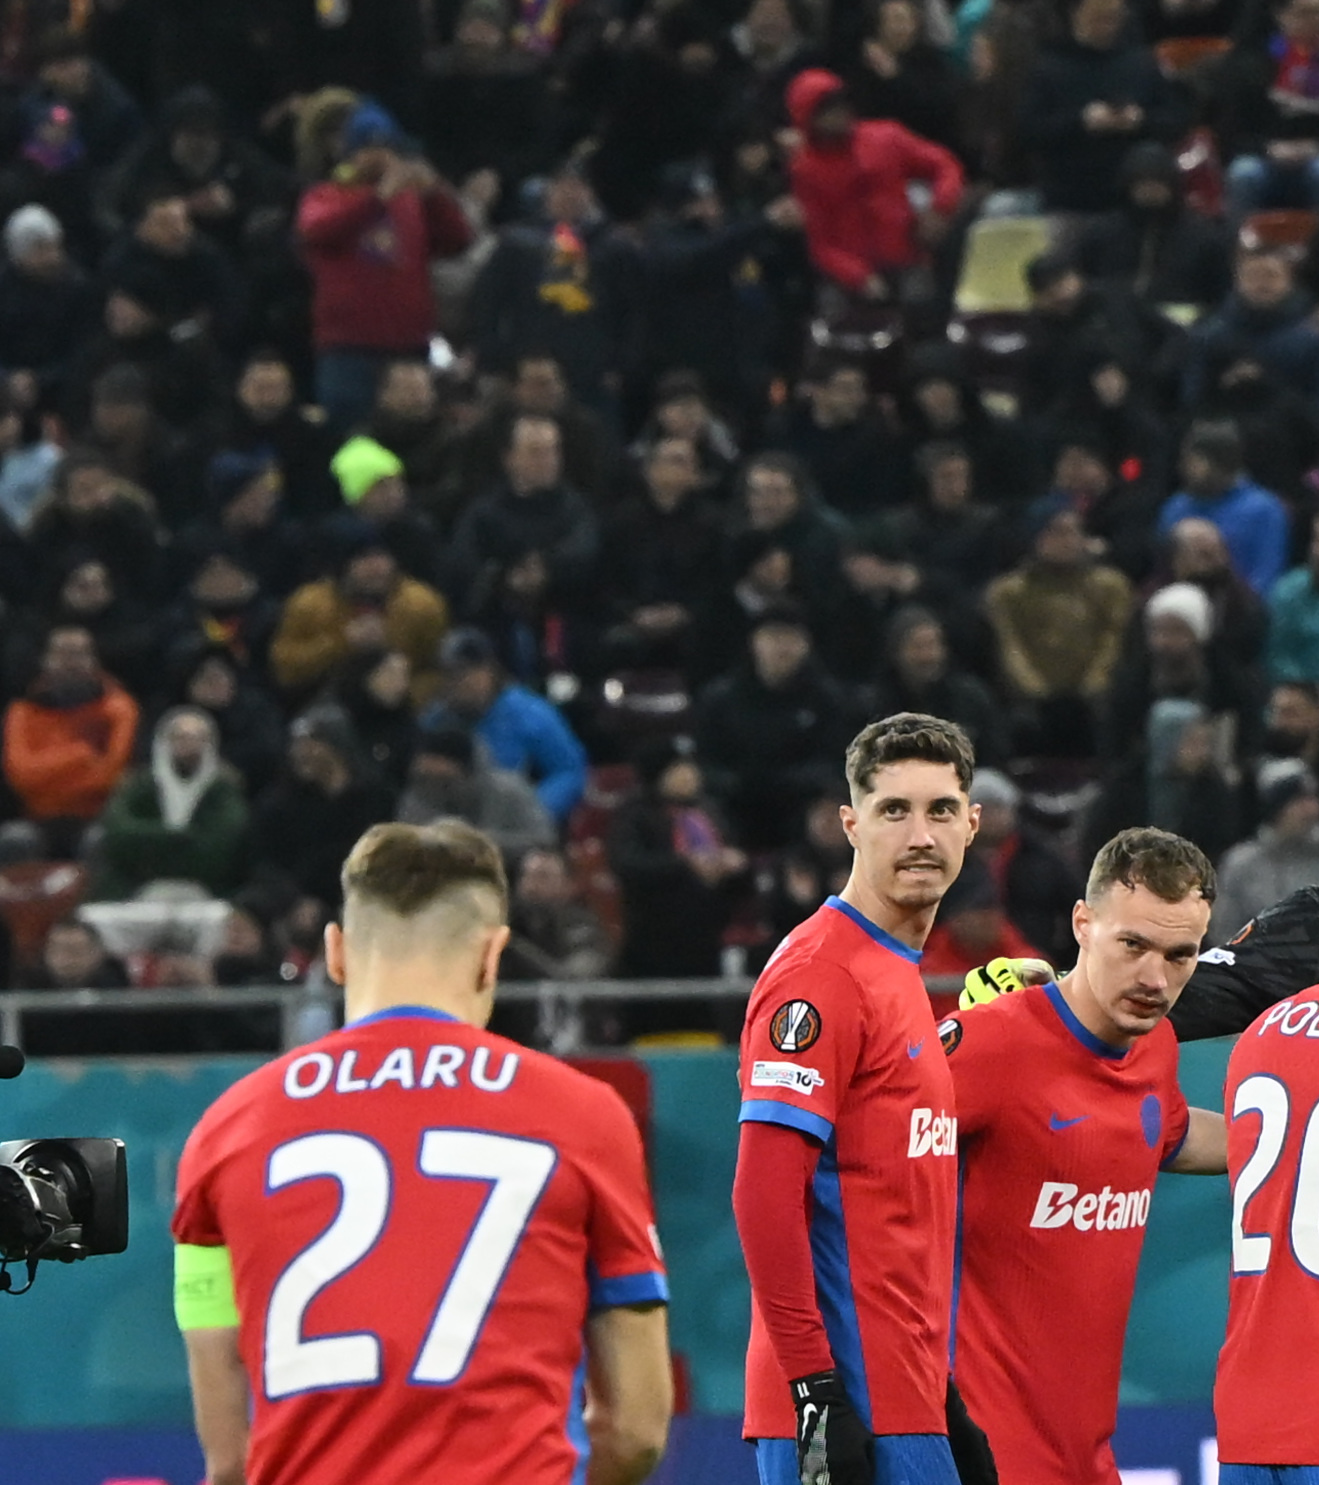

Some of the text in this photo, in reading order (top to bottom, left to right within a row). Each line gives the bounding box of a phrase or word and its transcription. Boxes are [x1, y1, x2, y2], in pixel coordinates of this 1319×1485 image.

[282, 1043, 521, 1100] OLARU
[907, 1107, 958, 1158] Beta
[1030, 1181, 1152, 1232] Betano
[263, 1126, 558, 1402] 27
